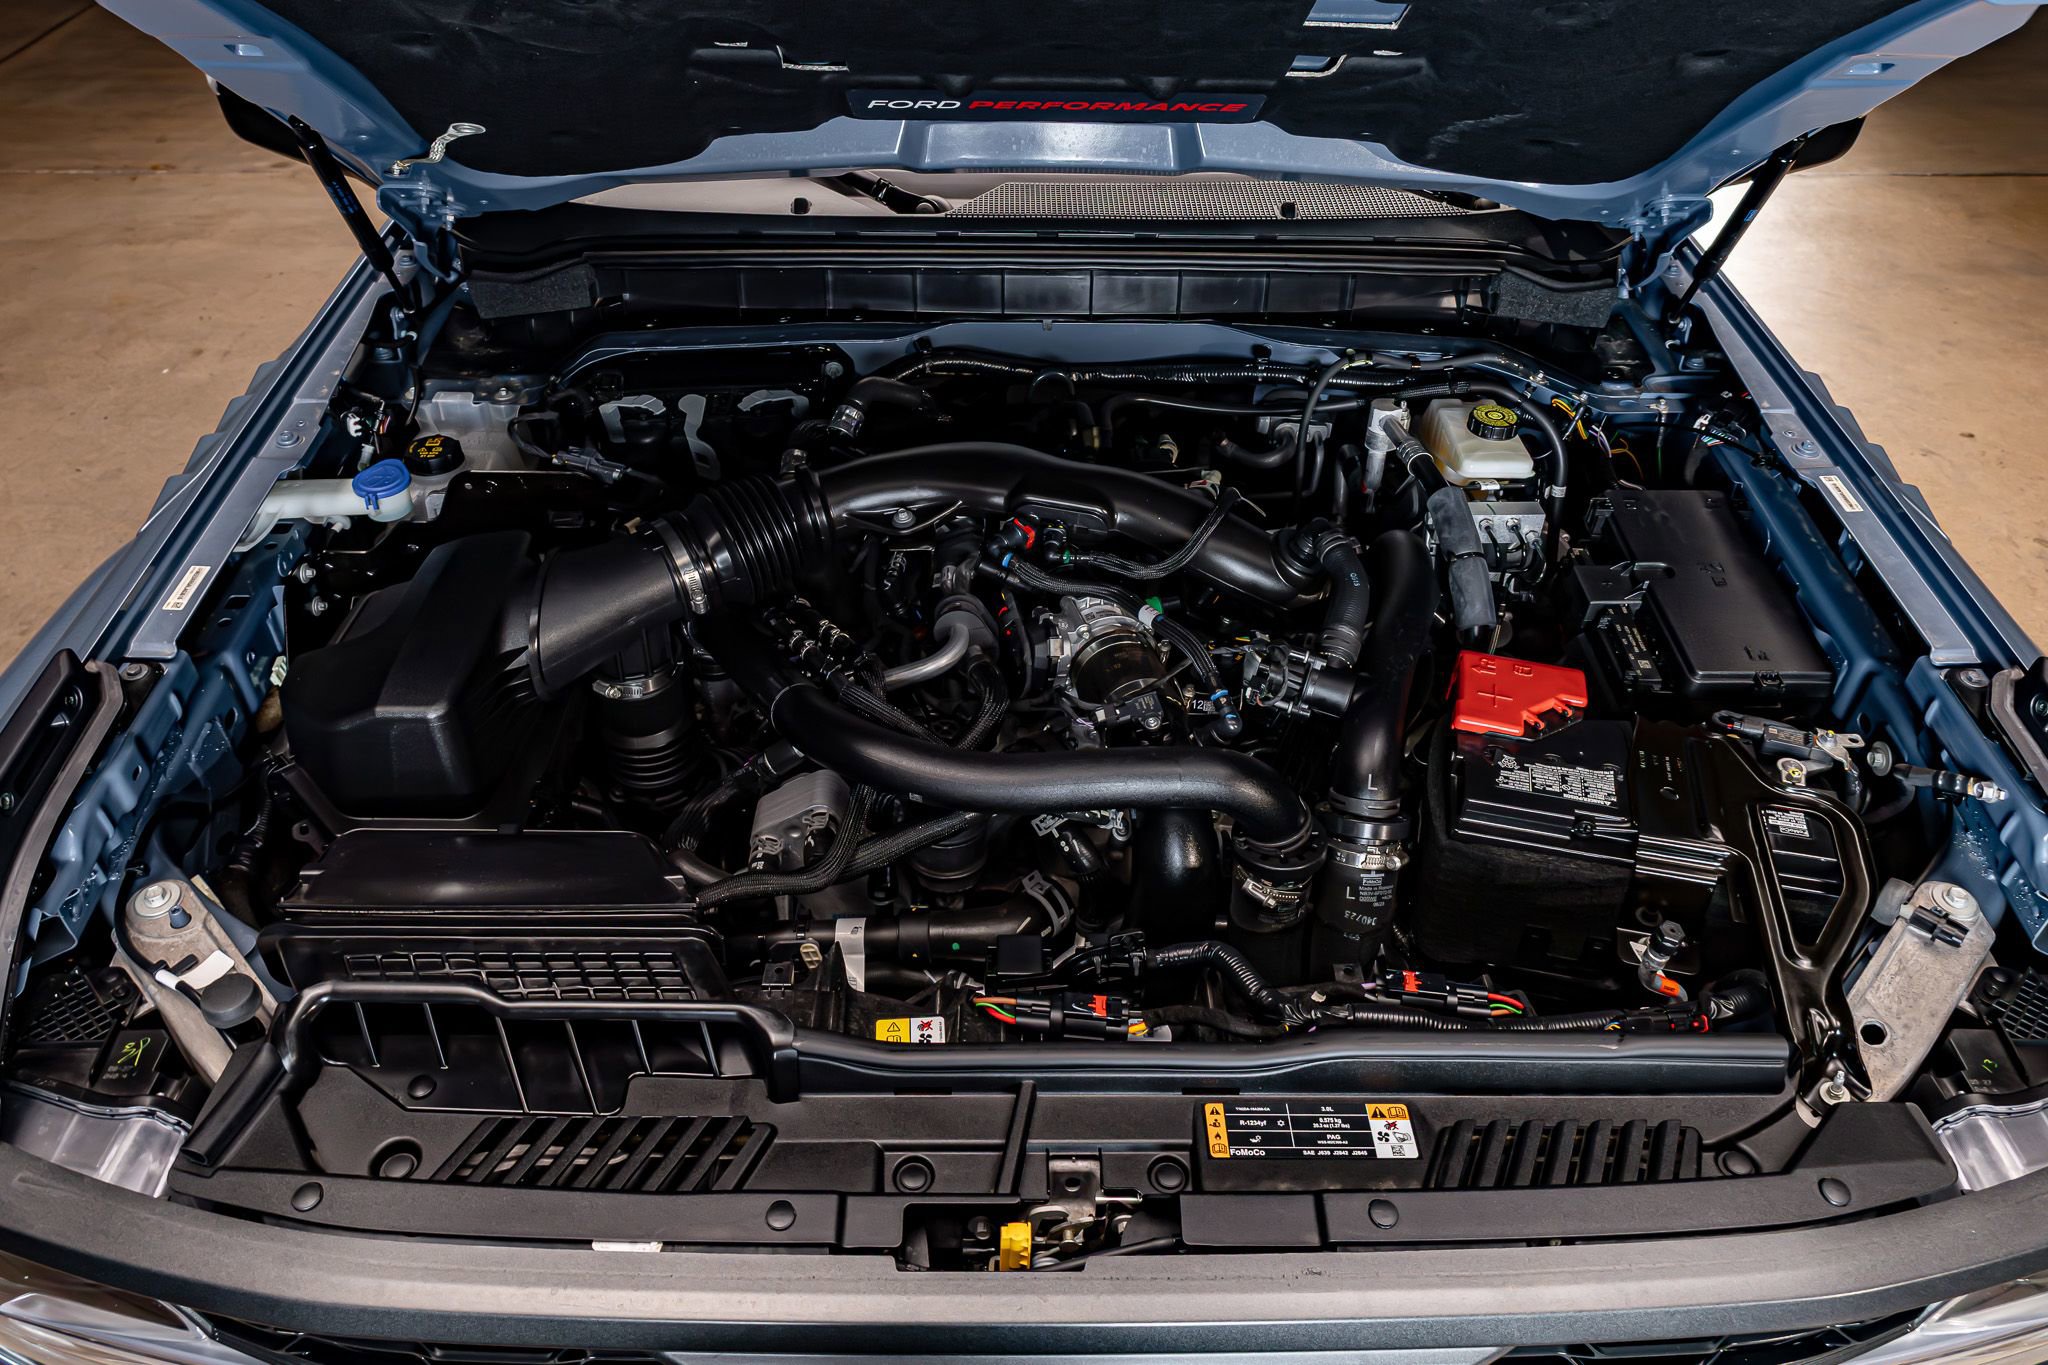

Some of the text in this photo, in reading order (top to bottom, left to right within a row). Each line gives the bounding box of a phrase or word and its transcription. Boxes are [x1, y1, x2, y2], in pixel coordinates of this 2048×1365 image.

[867, 99, 1249, 112] FORD PERFORMANCE
[1367, 773, 1378, 791] L
[1346, 886, 1356, 900] L
[1229, 1148, 1266, 1156] FoMoCo
